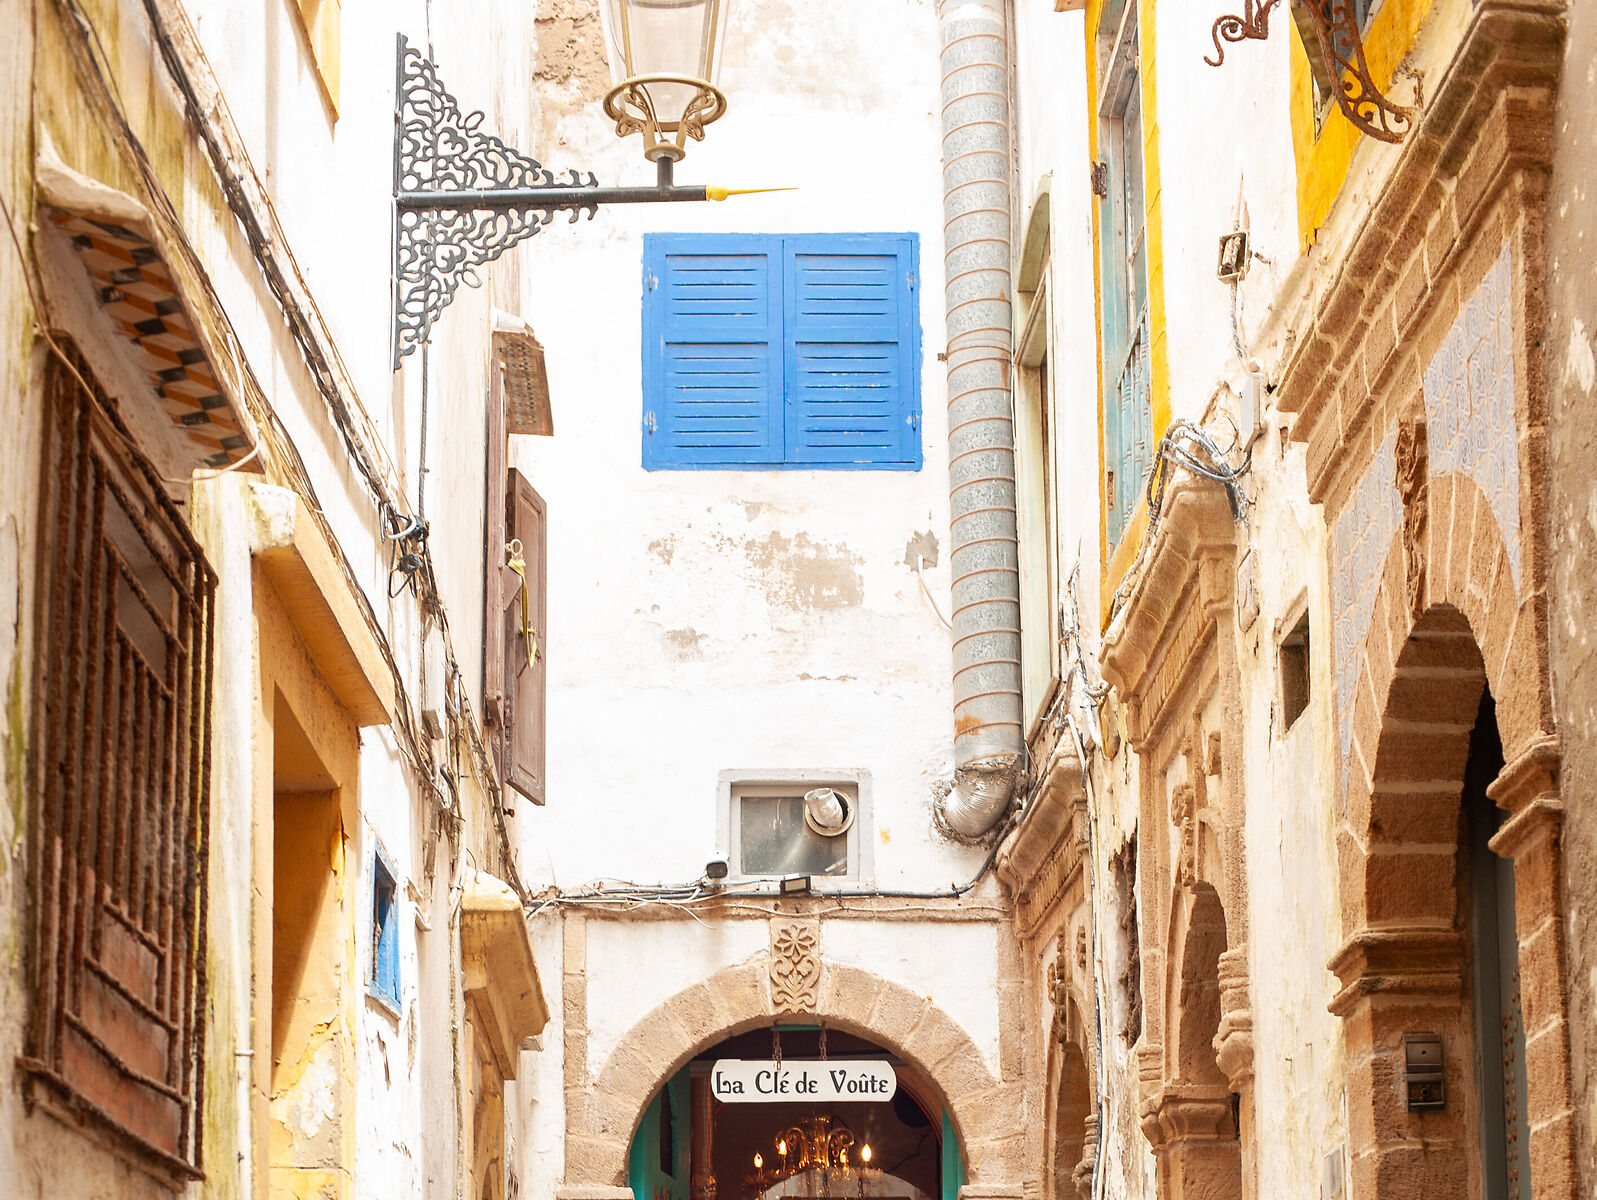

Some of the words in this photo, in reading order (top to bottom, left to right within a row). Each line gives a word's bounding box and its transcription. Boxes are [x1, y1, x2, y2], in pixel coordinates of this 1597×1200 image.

[715, 1071, 746, 1095] La
[754, 1070, 791, 1095] Clé
[795, 1071, 819, 1094] de
[829, 1069, 889, 1095] Voûte
